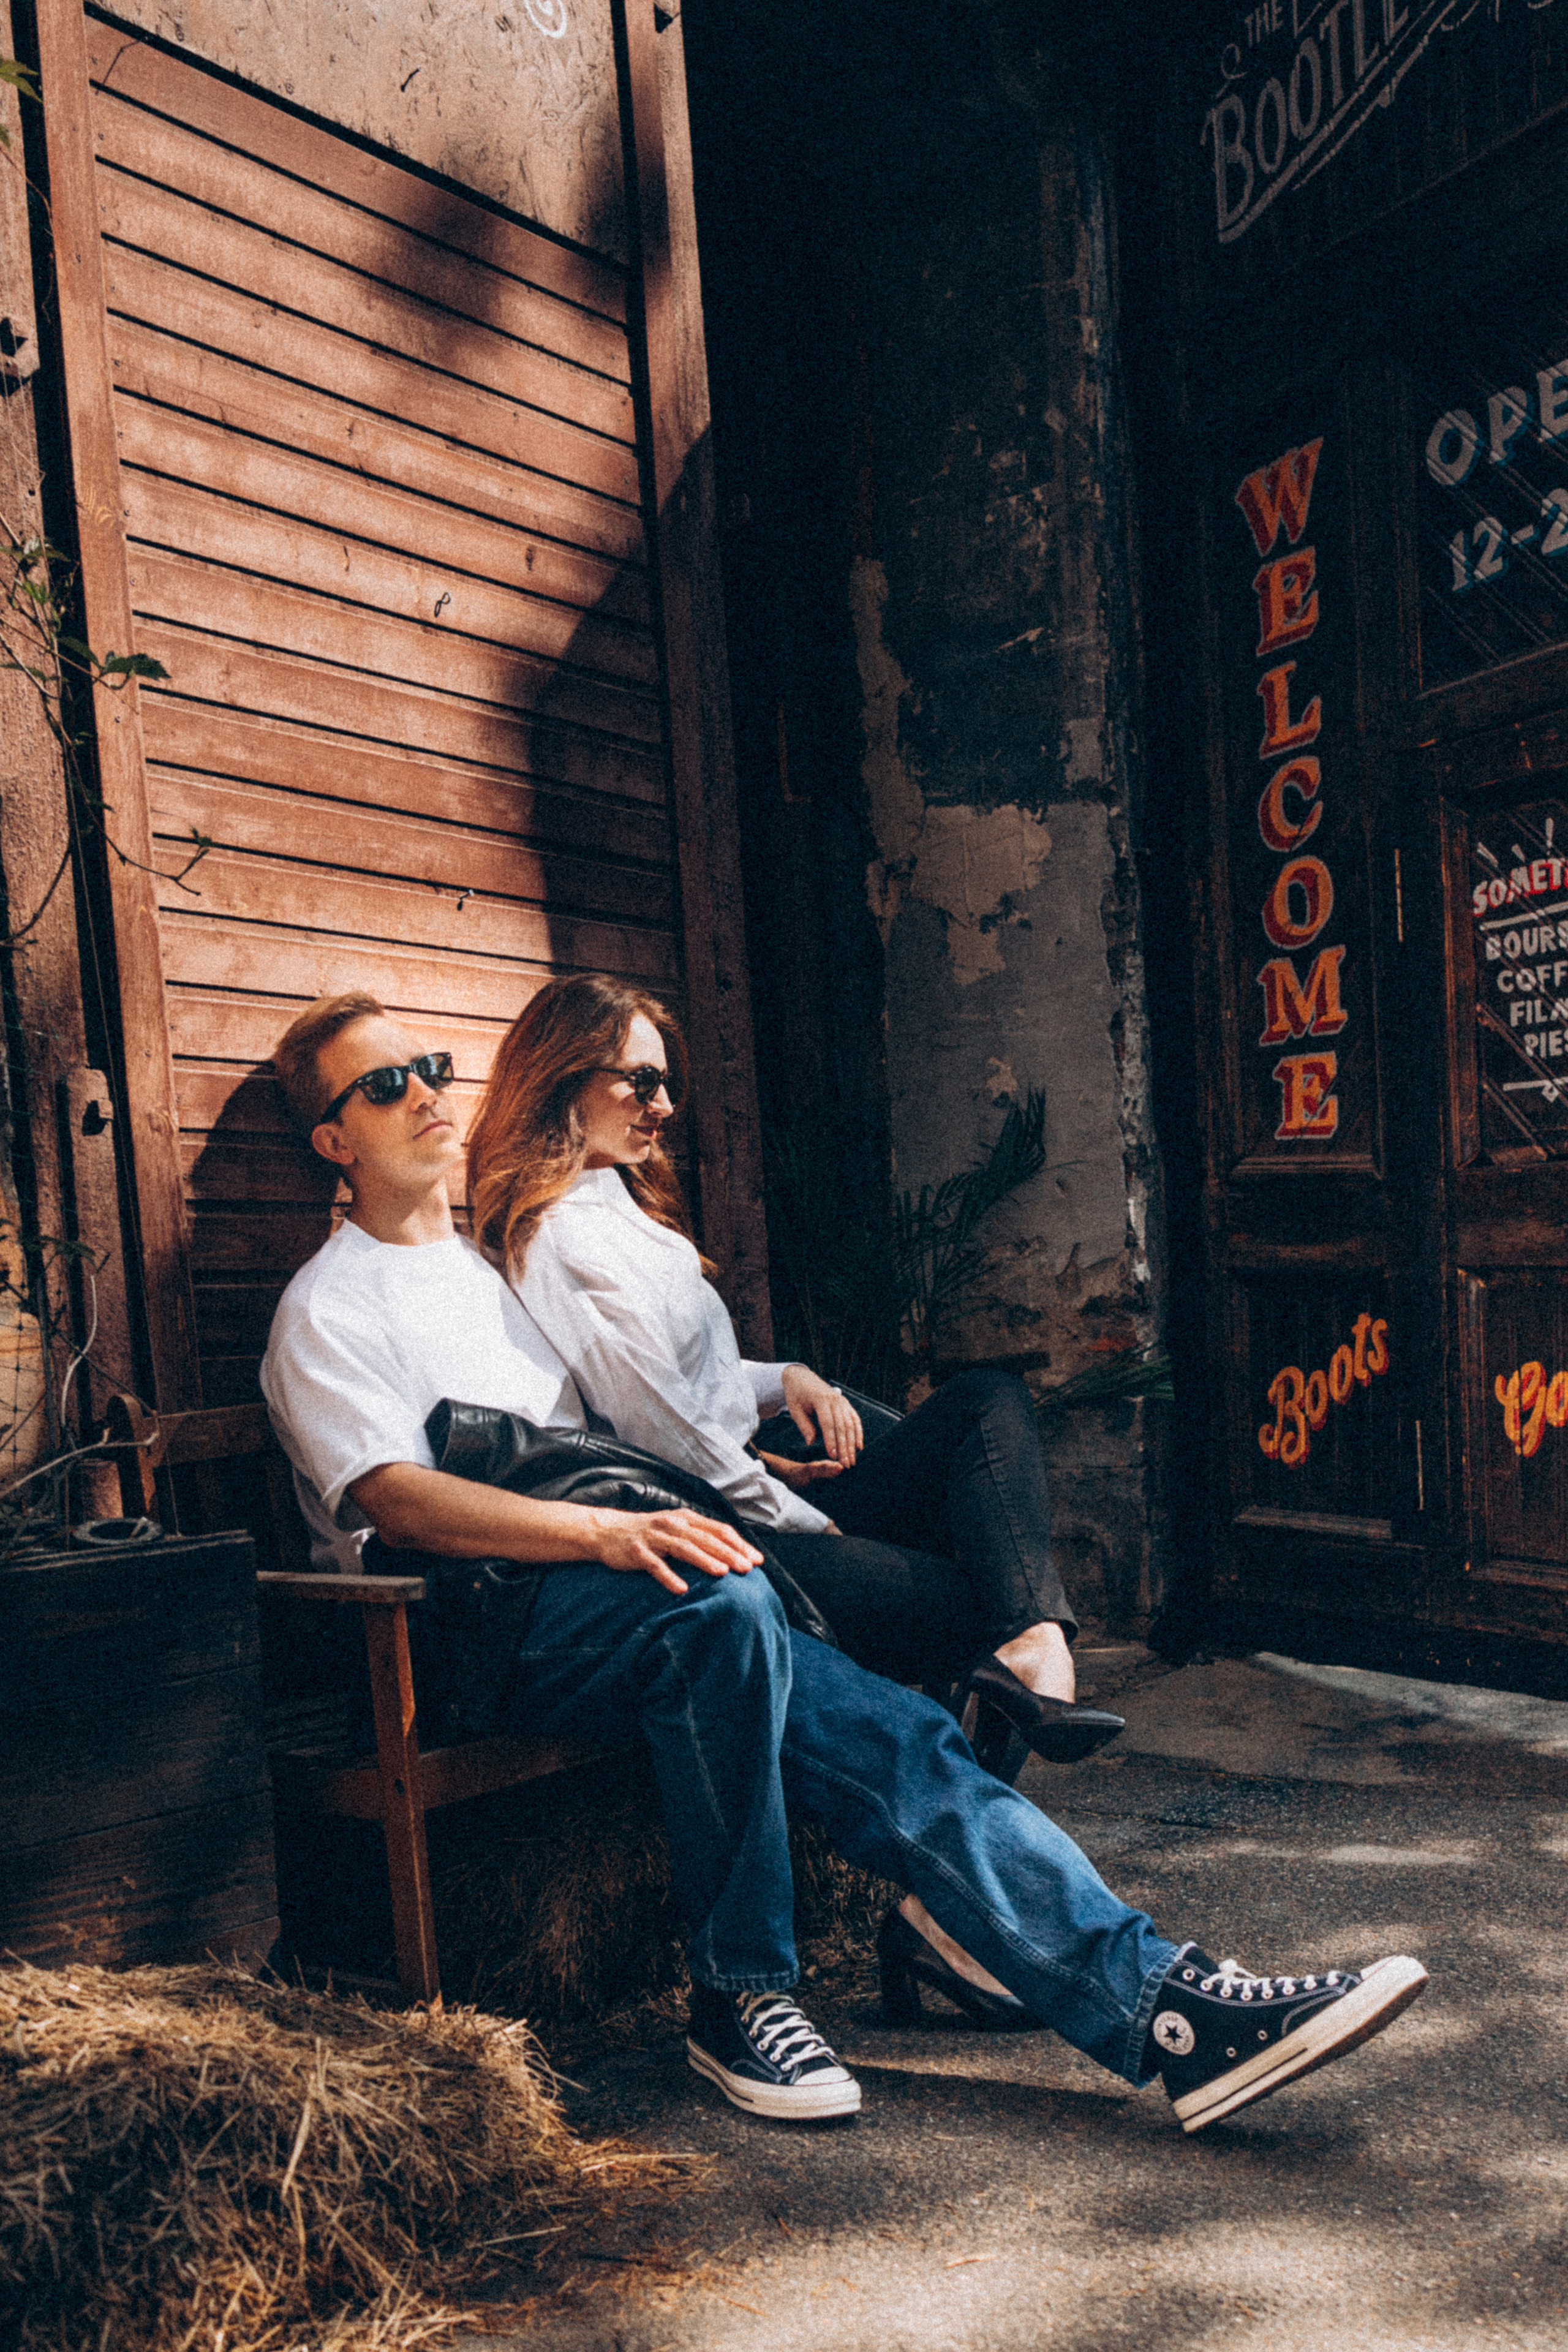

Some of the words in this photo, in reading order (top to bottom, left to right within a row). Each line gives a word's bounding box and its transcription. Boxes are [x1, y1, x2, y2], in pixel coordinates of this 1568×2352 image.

[1244, 0, 1284, 48] THE
[1425, 358, 1568, 486] OPE
[1235, 435, 1348, 1141] WELCOME
[1472, 858, 1568, 918] SOMET
[1496, 960, 1568, 993] COFF
[1258, 1312, 1389, 1469] Boots
